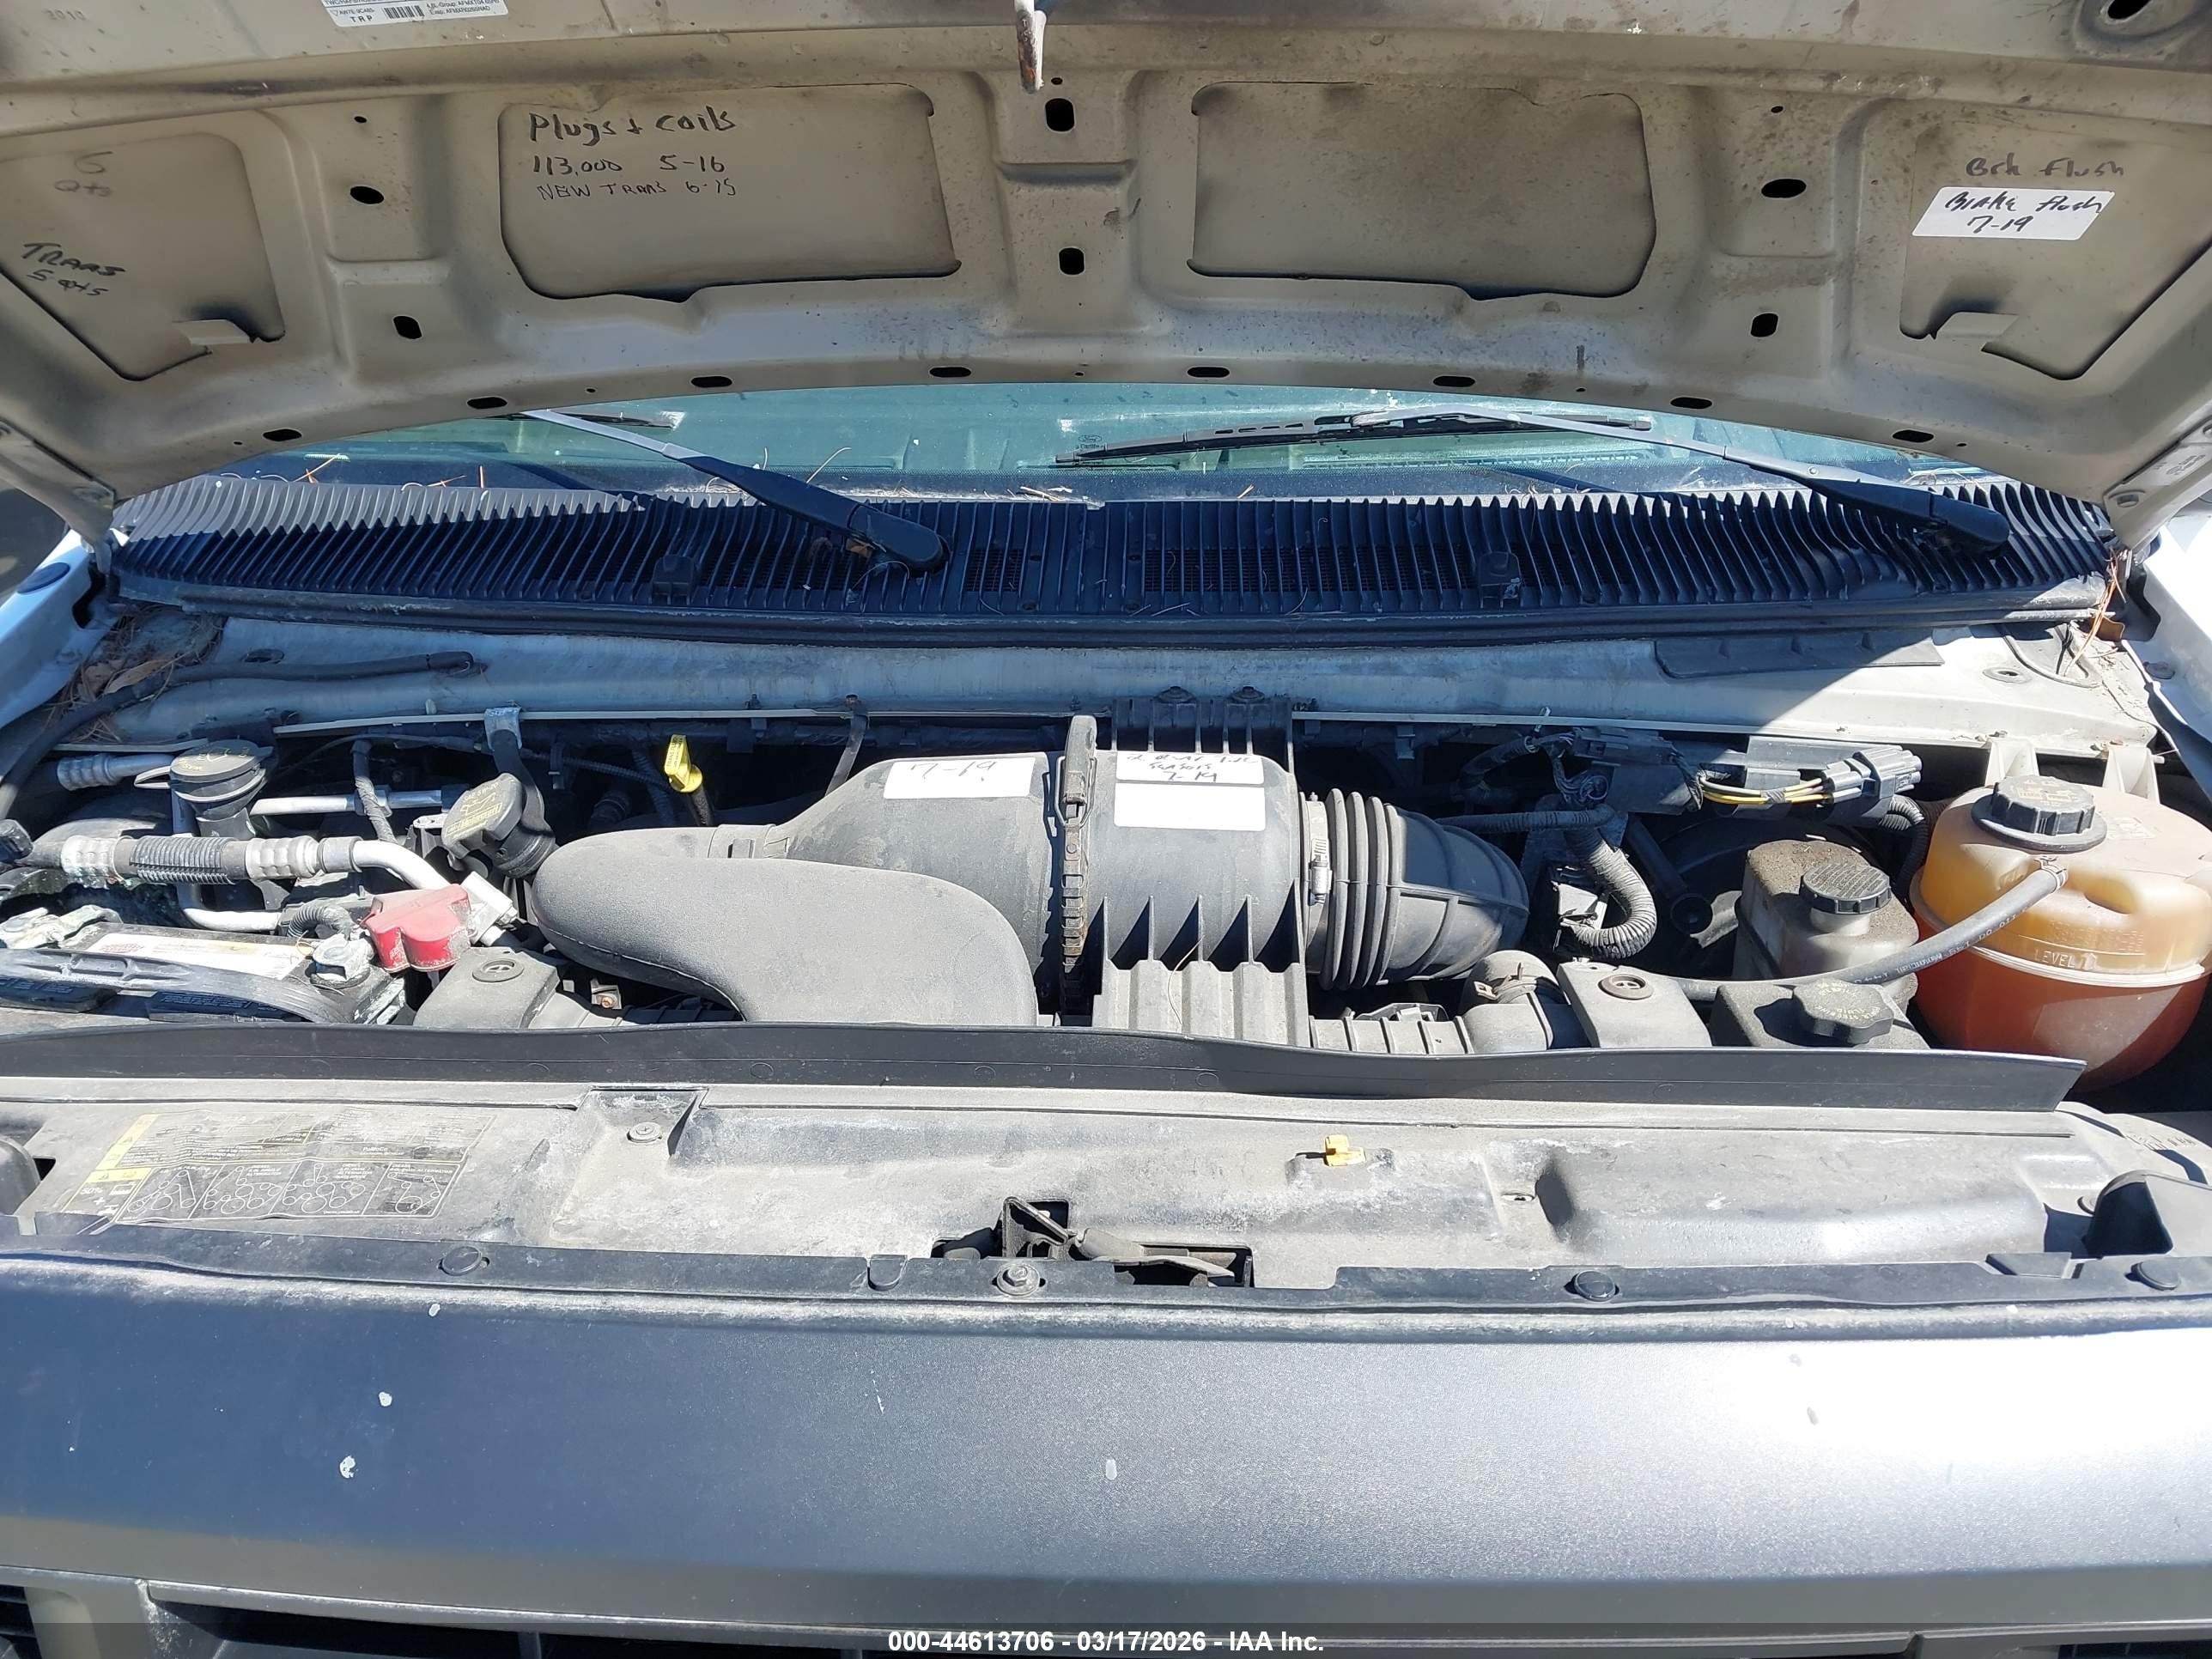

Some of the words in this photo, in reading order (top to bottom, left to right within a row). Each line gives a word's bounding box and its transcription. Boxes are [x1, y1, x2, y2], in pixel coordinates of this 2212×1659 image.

[529, 112, 617, 147] Plugs
[533, 155, 623, 177] 113,000
[659, 155, 726, 173] 5-16
[537, 184, 591, 201] NEW
[686, 179, 737, 197] 6-15
[1966, 215, 2034, 234] 7-19
[2033, 949, 2075, 968] LEVEL
